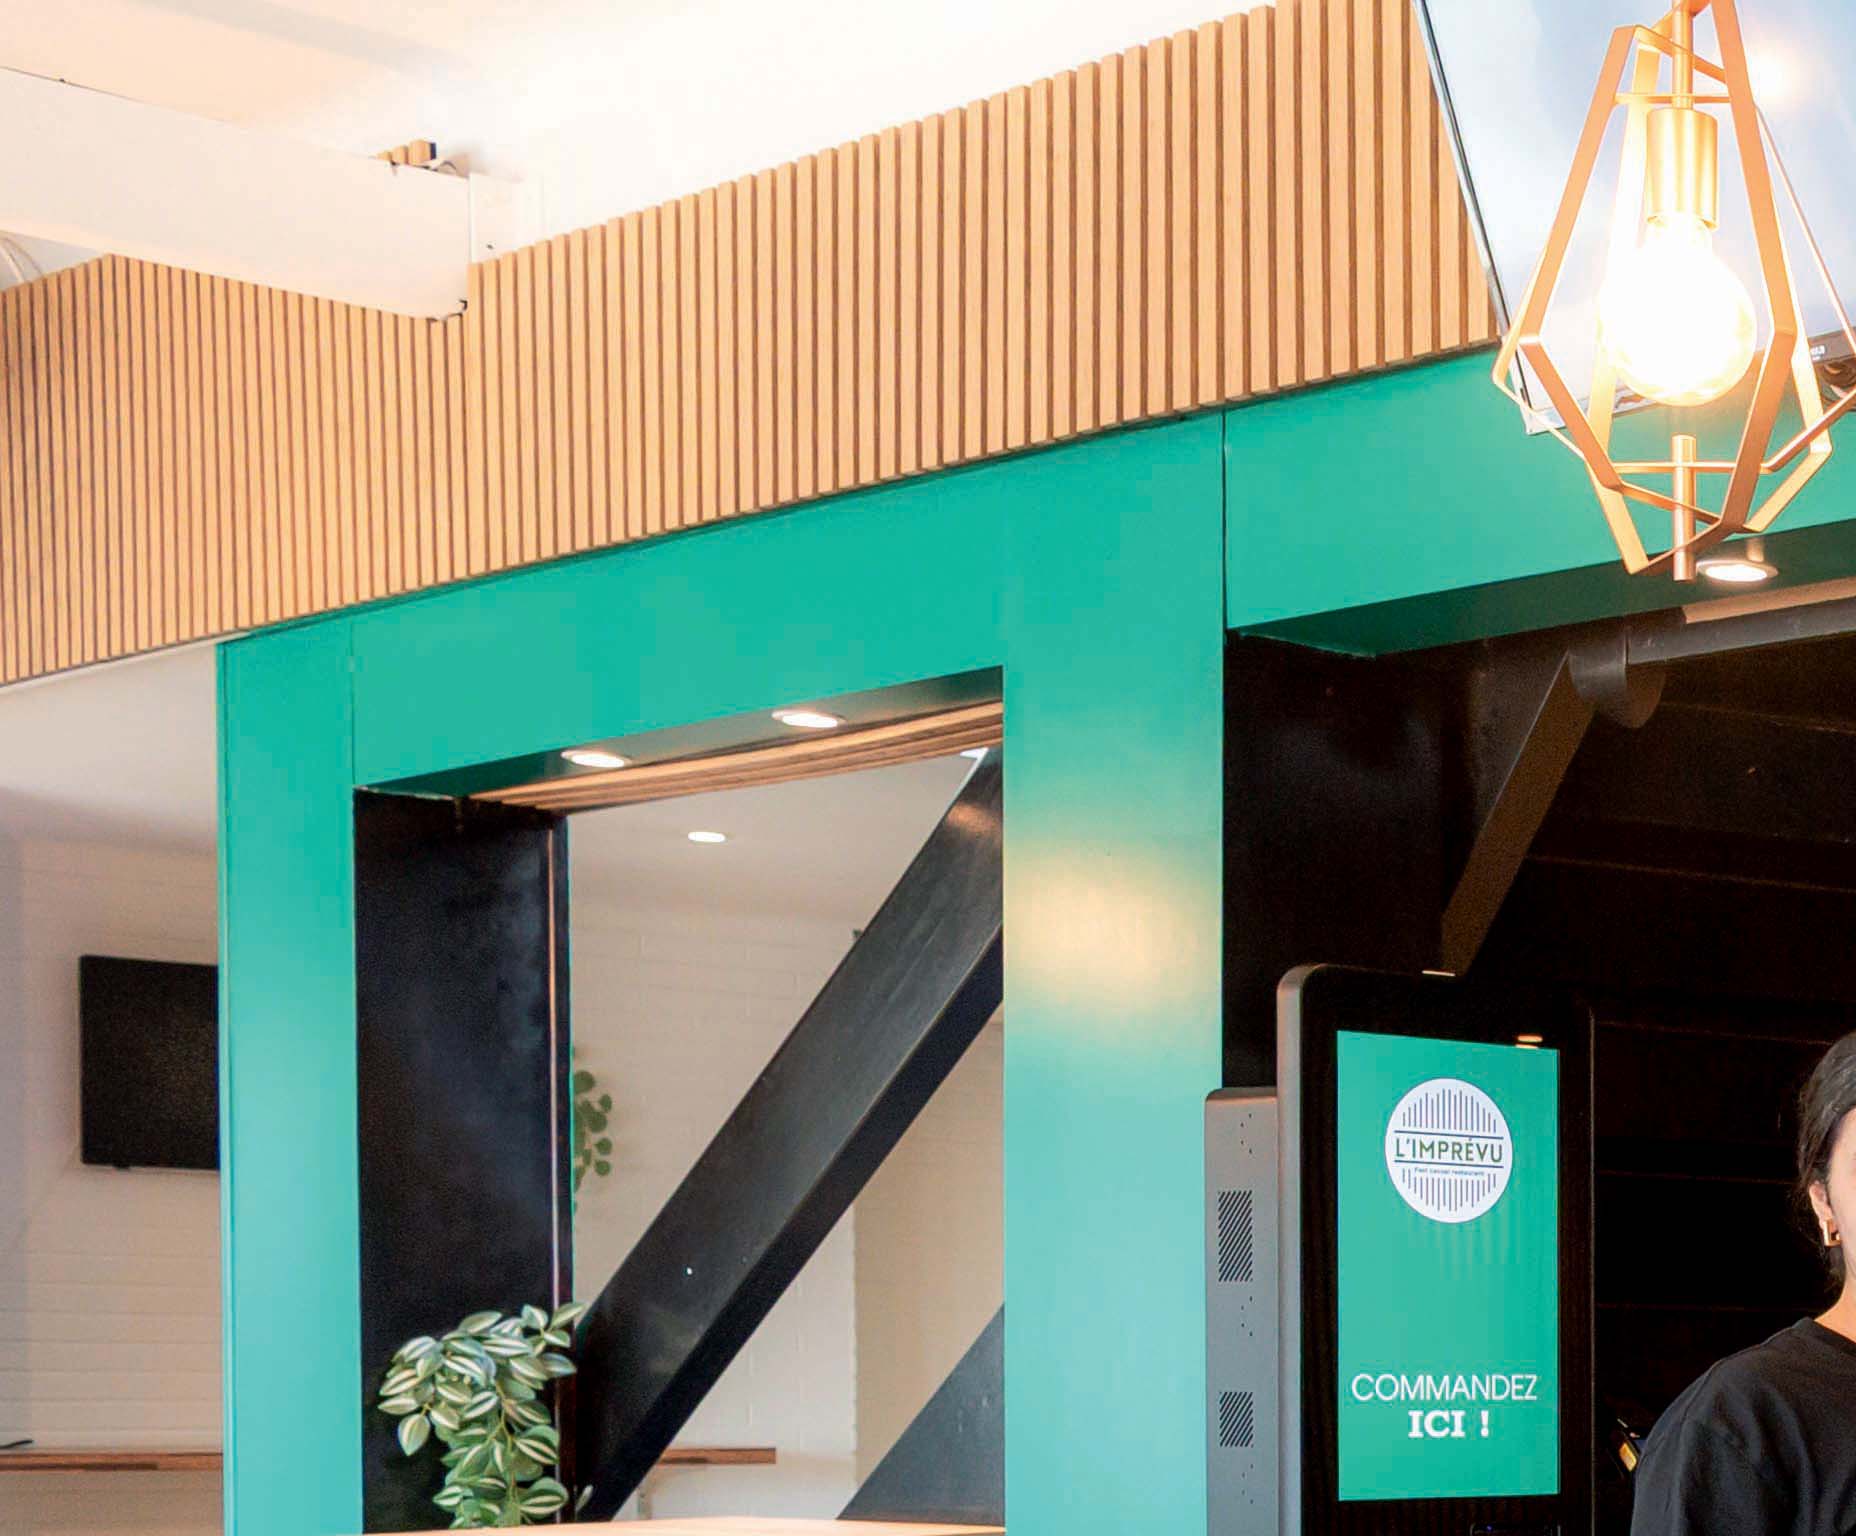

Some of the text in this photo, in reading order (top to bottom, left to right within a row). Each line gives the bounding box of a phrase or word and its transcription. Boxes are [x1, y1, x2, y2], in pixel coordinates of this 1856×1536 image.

[1396, 1137, 1503, 1163] L'IMPRÉVU
[1351, 1373, 1538, 1401] COMMANDEZ
[1408, 1409, 1490, 1438] ICI !
